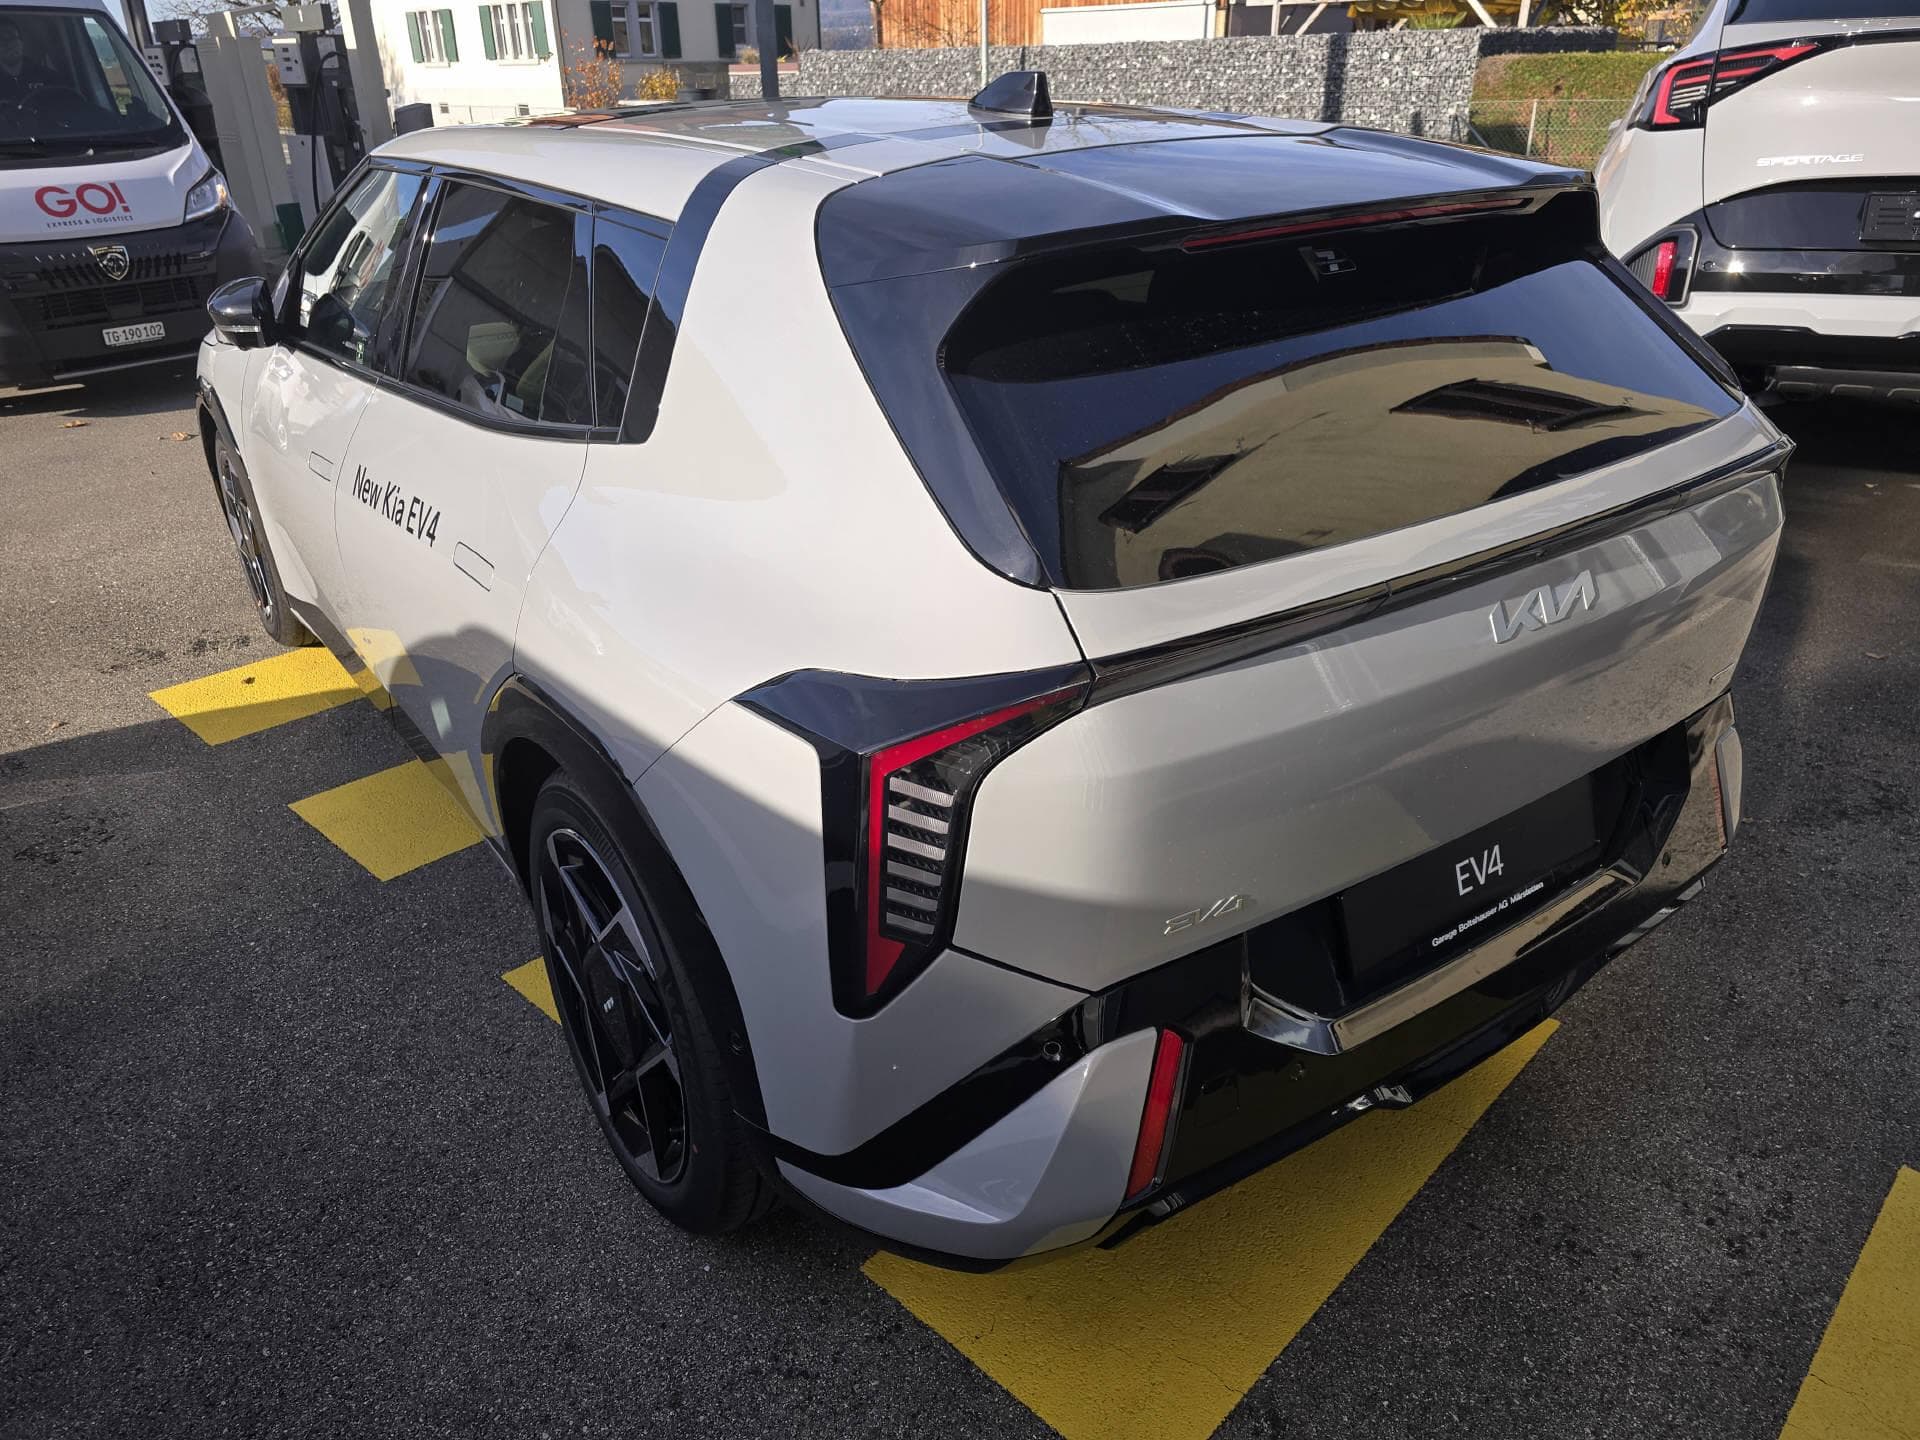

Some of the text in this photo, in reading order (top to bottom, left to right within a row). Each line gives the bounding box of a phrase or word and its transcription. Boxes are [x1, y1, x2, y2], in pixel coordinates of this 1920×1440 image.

[1756, 153, 1865, 167] SPORTAGE
[35, 182, 131, 218] GO!
[46, 219, 82, 228] EXPRESS
[92, 215, 134, 224] LOGISTICS
[353, 464, 440, 548] New Kia EV4
[1455, 844, 1504, 896] EV4
[1163, 895, 1246, 935] EV4
[1431, 929, 1458, 947] Garage
[1458, 906, 1498, 933] Boltshauser
[1497, 899, 1509, 912] AG
